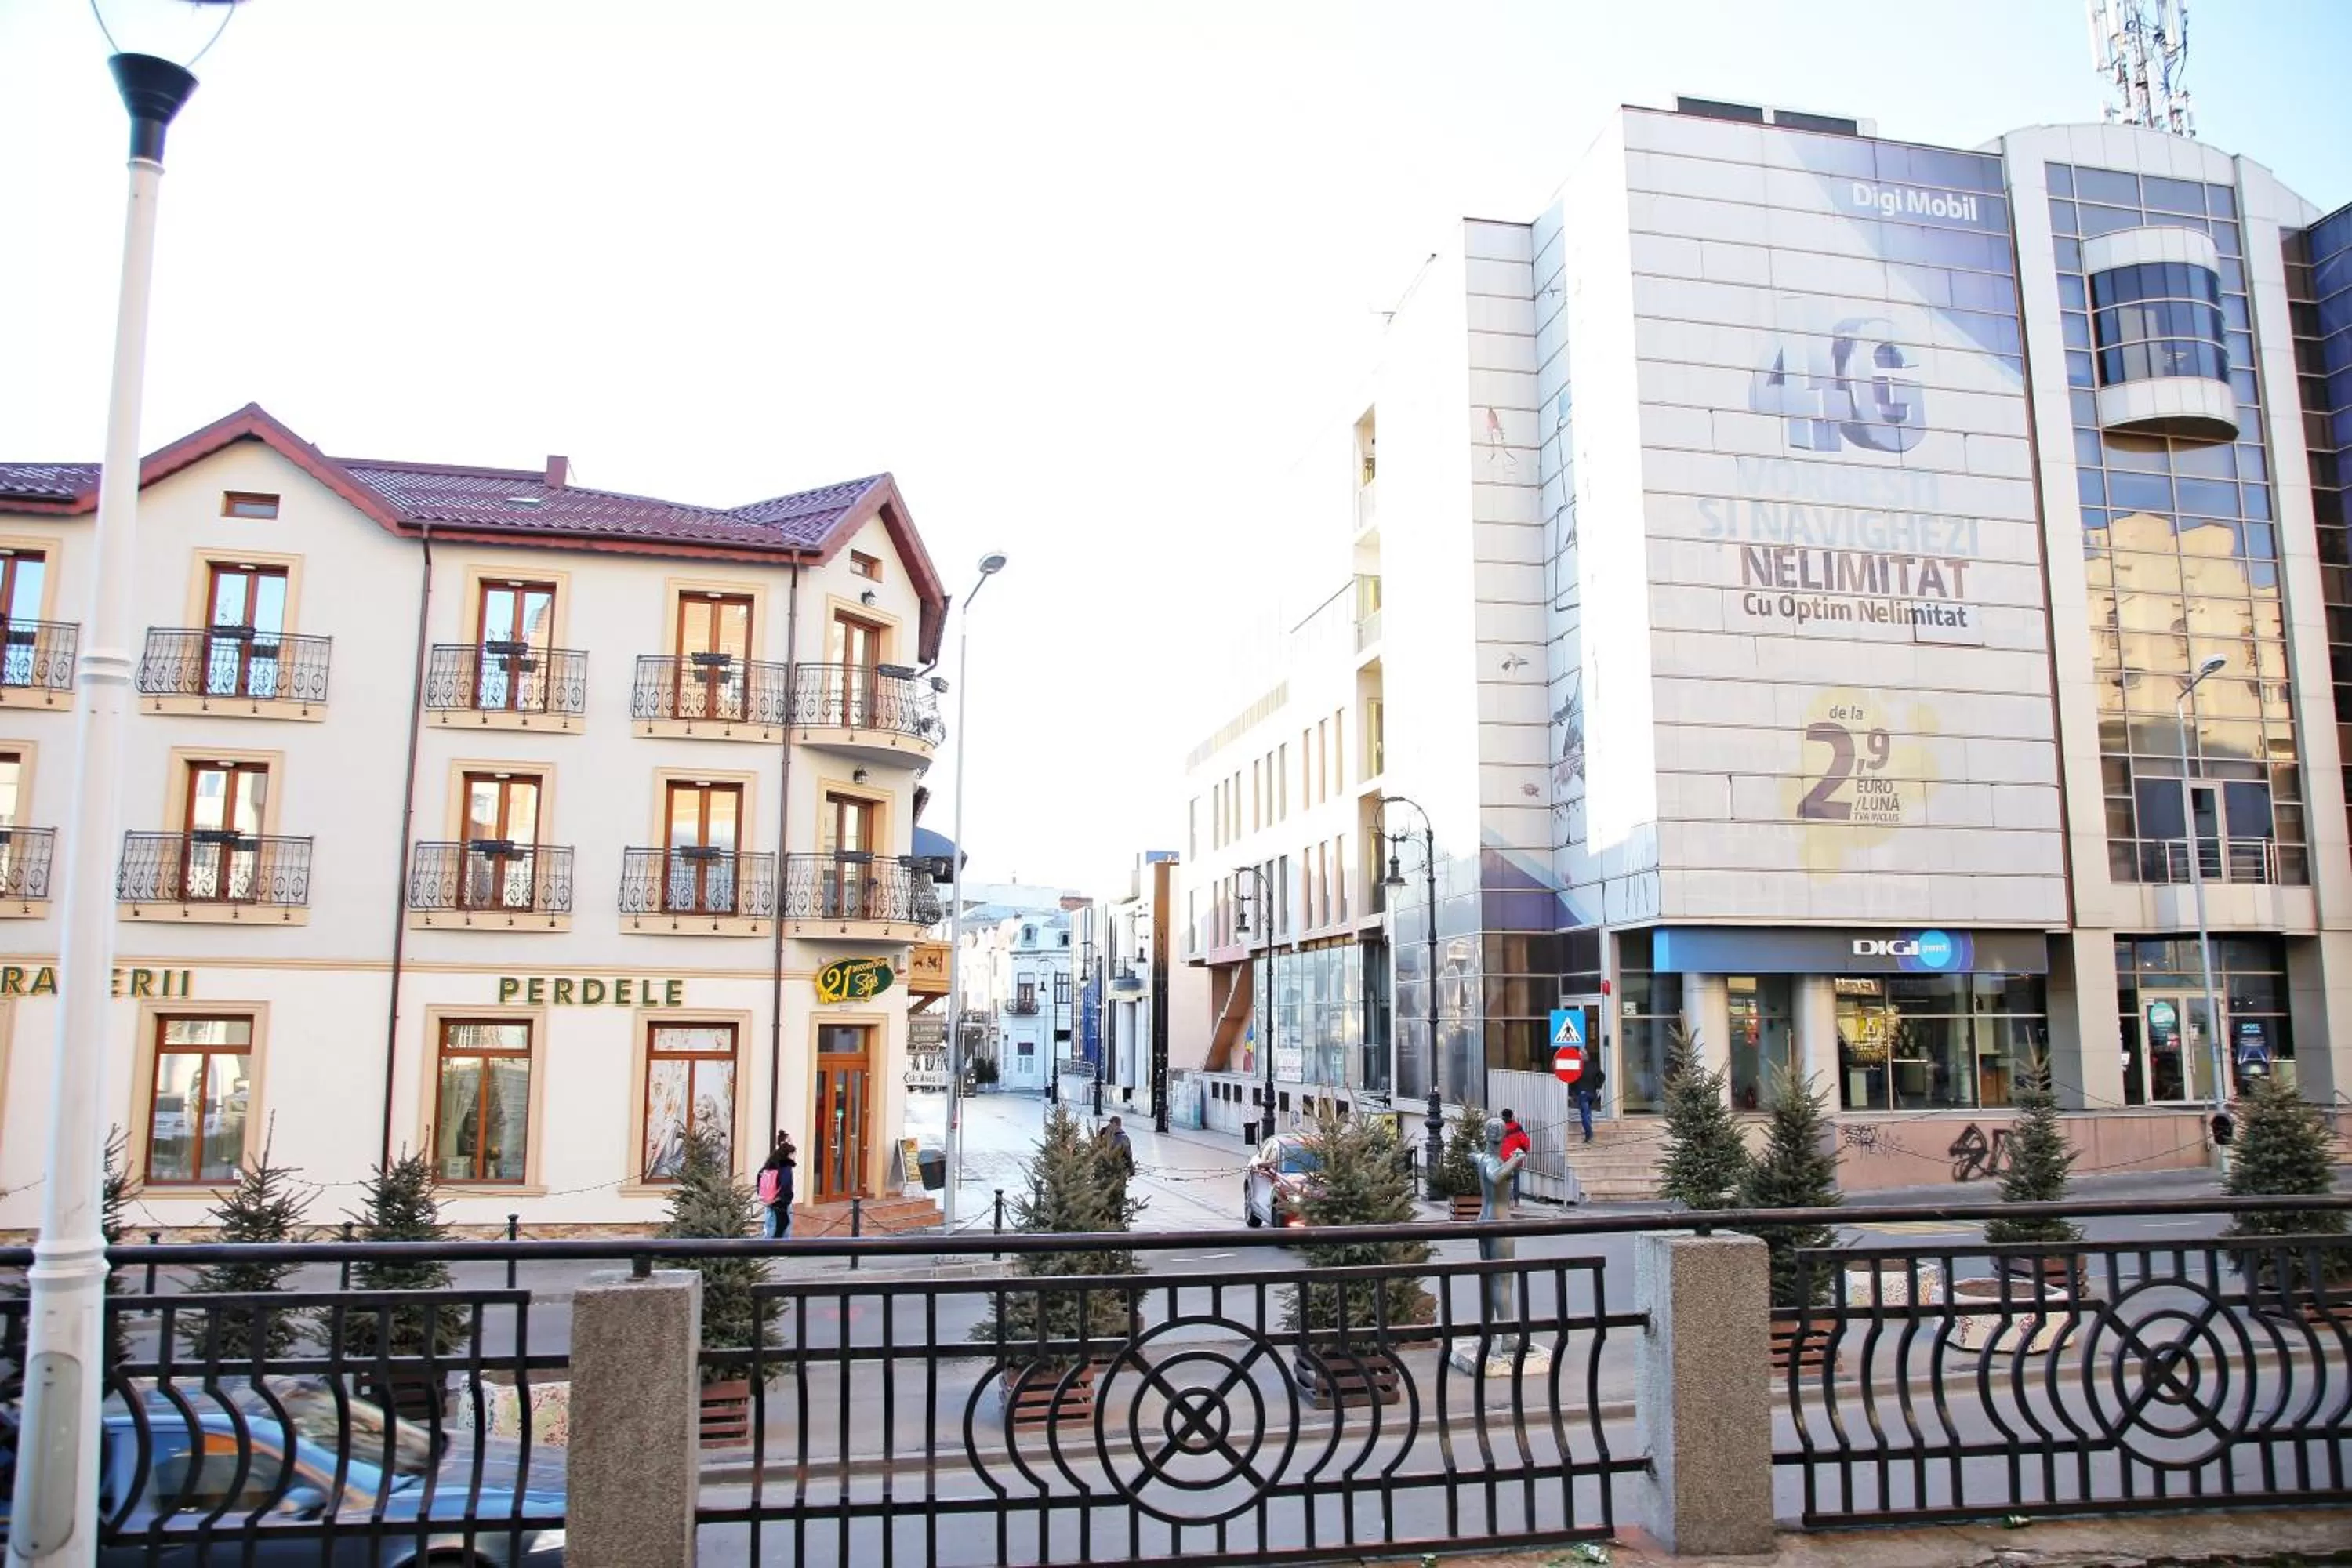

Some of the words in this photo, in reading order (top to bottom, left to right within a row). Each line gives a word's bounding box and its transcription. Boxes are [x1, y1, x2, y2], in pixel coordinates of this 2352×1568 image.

[1853, 183, 1903, 216] Digi
[1906, 189, 1977, 221] Mobil
[1749, 317, 1926, 453] 4G
[1750, 502, 1980, 556] NAVIGHEZI
[1740, 543, 1969, 599] NELIMITAT
[1743, 593, 1771, 616] Cu
[1778, 593, 1853, 625] Optim
[1857, 599, 1969, 628] Nelimitat
[1829, 705, 1846, 719] de
[1851, 706, 1864, 720] la
[1857, 779, 1893, 793] EURO
[1853, 940, 1920, 956] DIGI
[499, 978, 683, 1005] PERDELE
